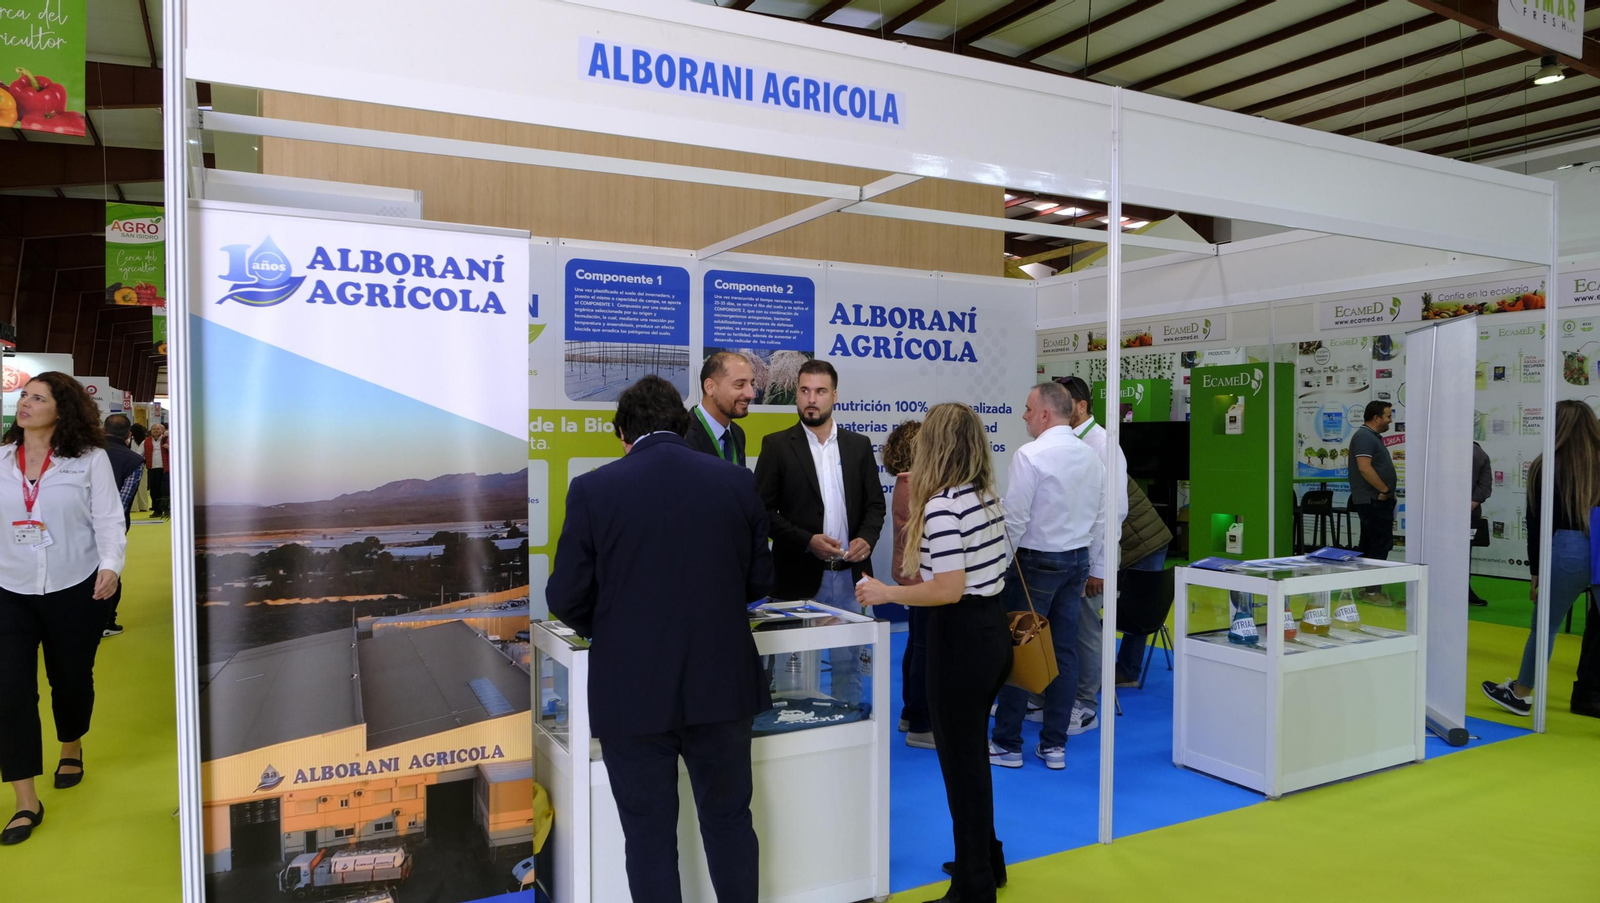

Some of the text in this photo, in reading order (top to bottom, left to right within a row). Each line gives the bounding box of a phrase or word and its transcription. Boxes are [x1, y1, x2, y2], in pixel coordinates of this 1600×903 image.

[38, 0, 68, 29] del
[1523, 7, 1566, 31] FRESH
[588, 42, 900, 125] ALBORANI AGRICOLA
[111, 220, 159, 235] AGRO
[251, 259, 287, 272] años
[306, 246, 505, 283] ALBORANÍ
[575, 269, 663, 286] Componente 1
[714, 279, 794, 294] Componente 2
[305, 278, 507, 315] AGRÍCOLA
[1467, 291, 1478, 299] en
[1480, 289, 1488, 297] la
[829, 302, 977, 333] ALBORANÍ
[1334, 316, 1384, 325] www.ecamed.es
[828, 331, 978, 363] AGRÍCOLA
[833, 400, 1012, 414] nutrición 100% alizada
[529, 416, 615, 433] de la Bio
[292, 744, 505, 784] ALBORANI AGRICOLA
